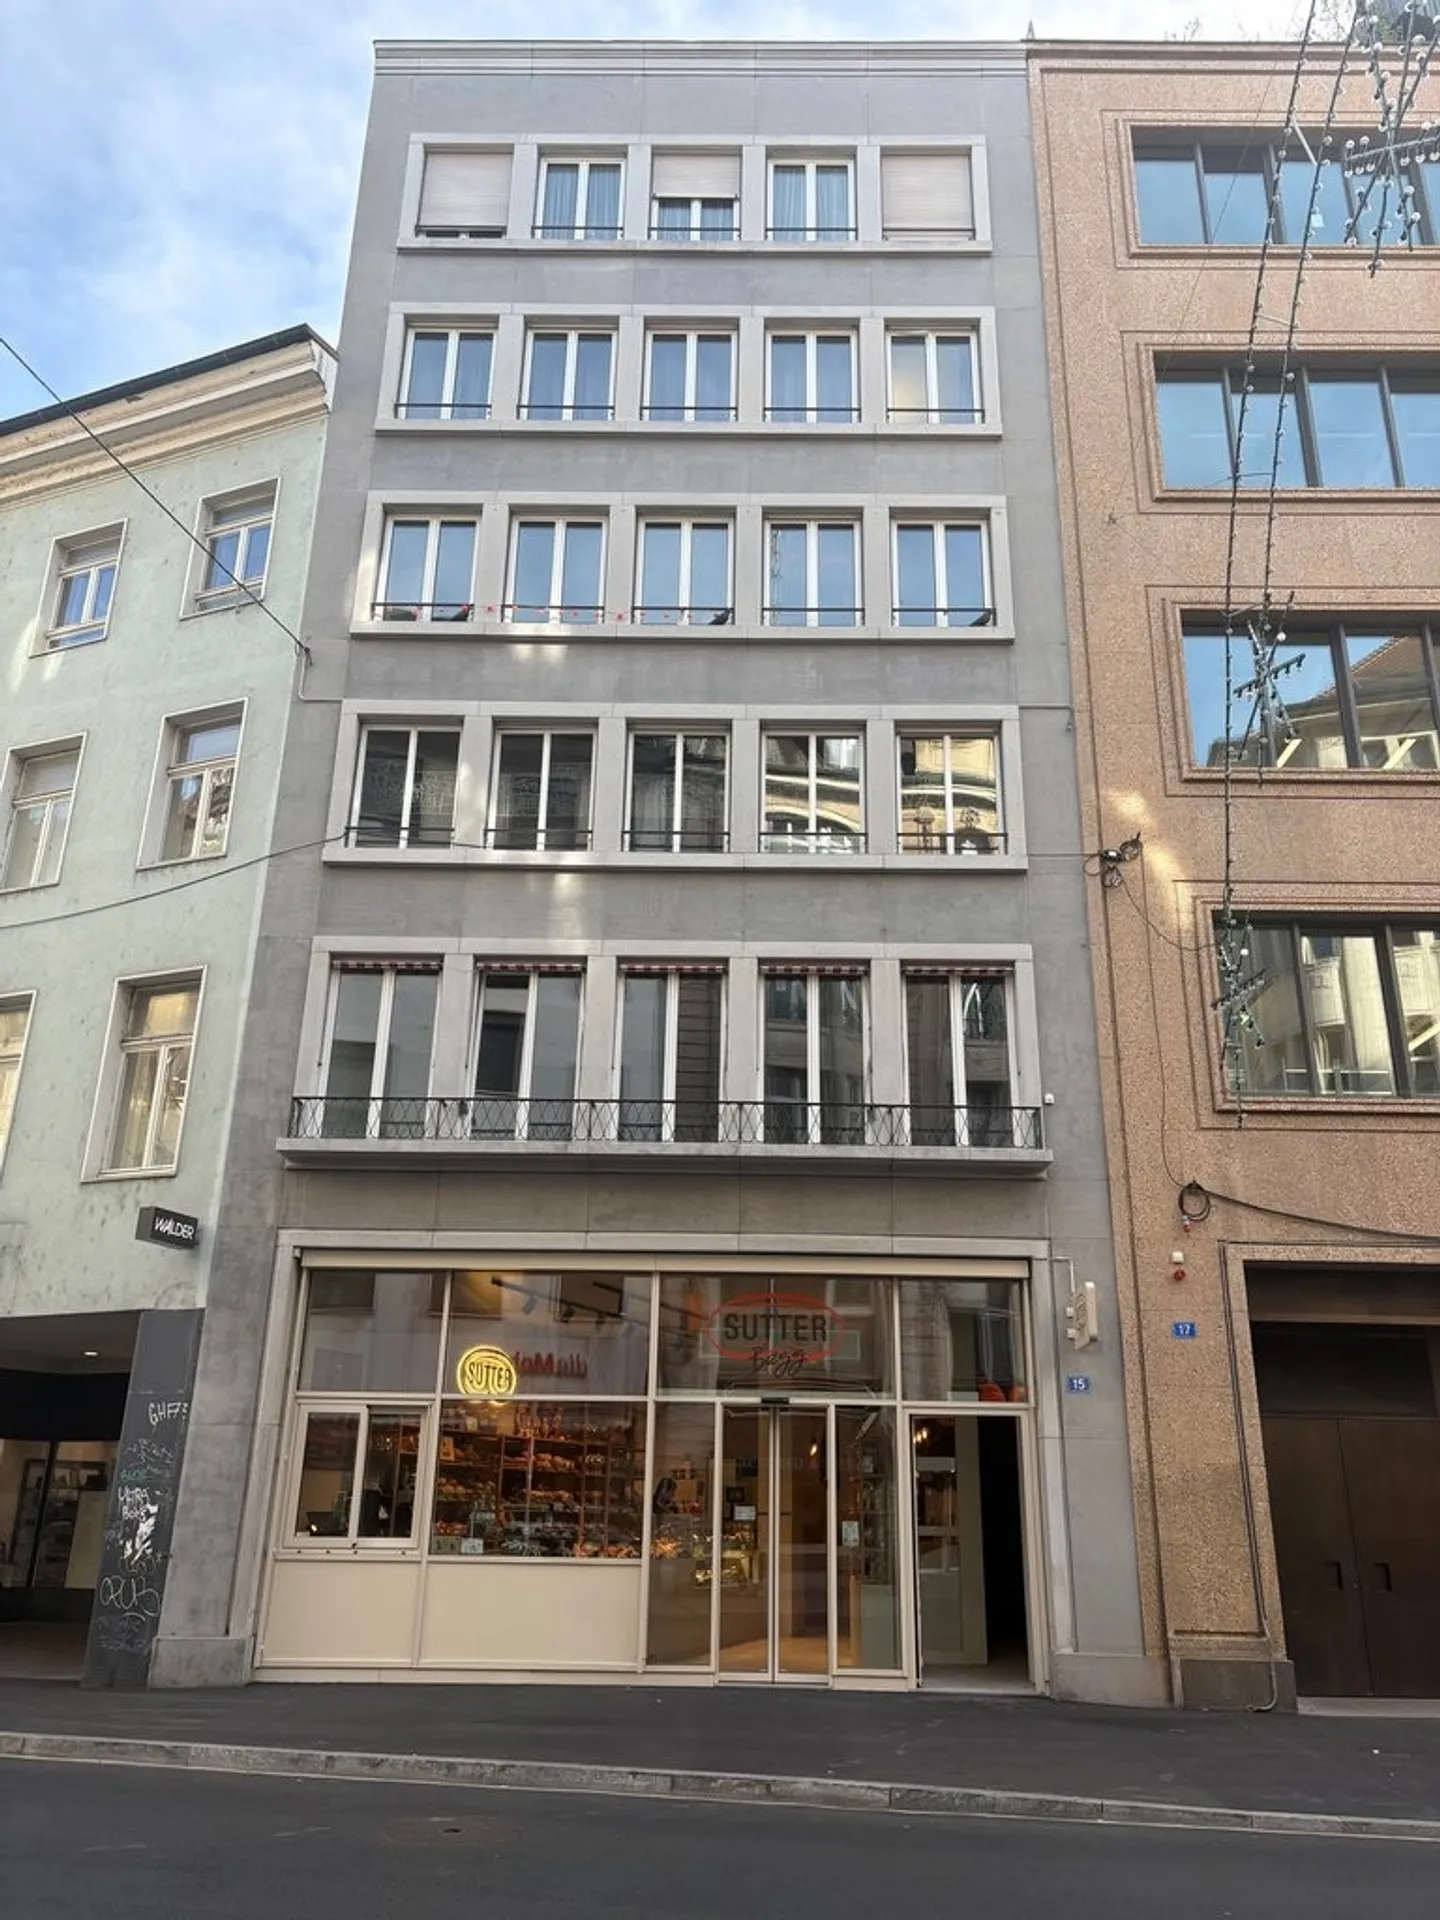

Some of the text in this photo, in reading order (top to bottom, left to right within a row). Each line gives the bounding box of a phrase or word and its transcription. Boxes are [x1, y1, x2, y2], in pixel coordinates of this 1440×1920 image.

[723, 1313, 827, 1342] SUTTER
[1178, 1324, 1190, 1336] 17
[468, 1361, 512, 1389] SUTTER
[1072, 1378, 1086, 1390] 15
